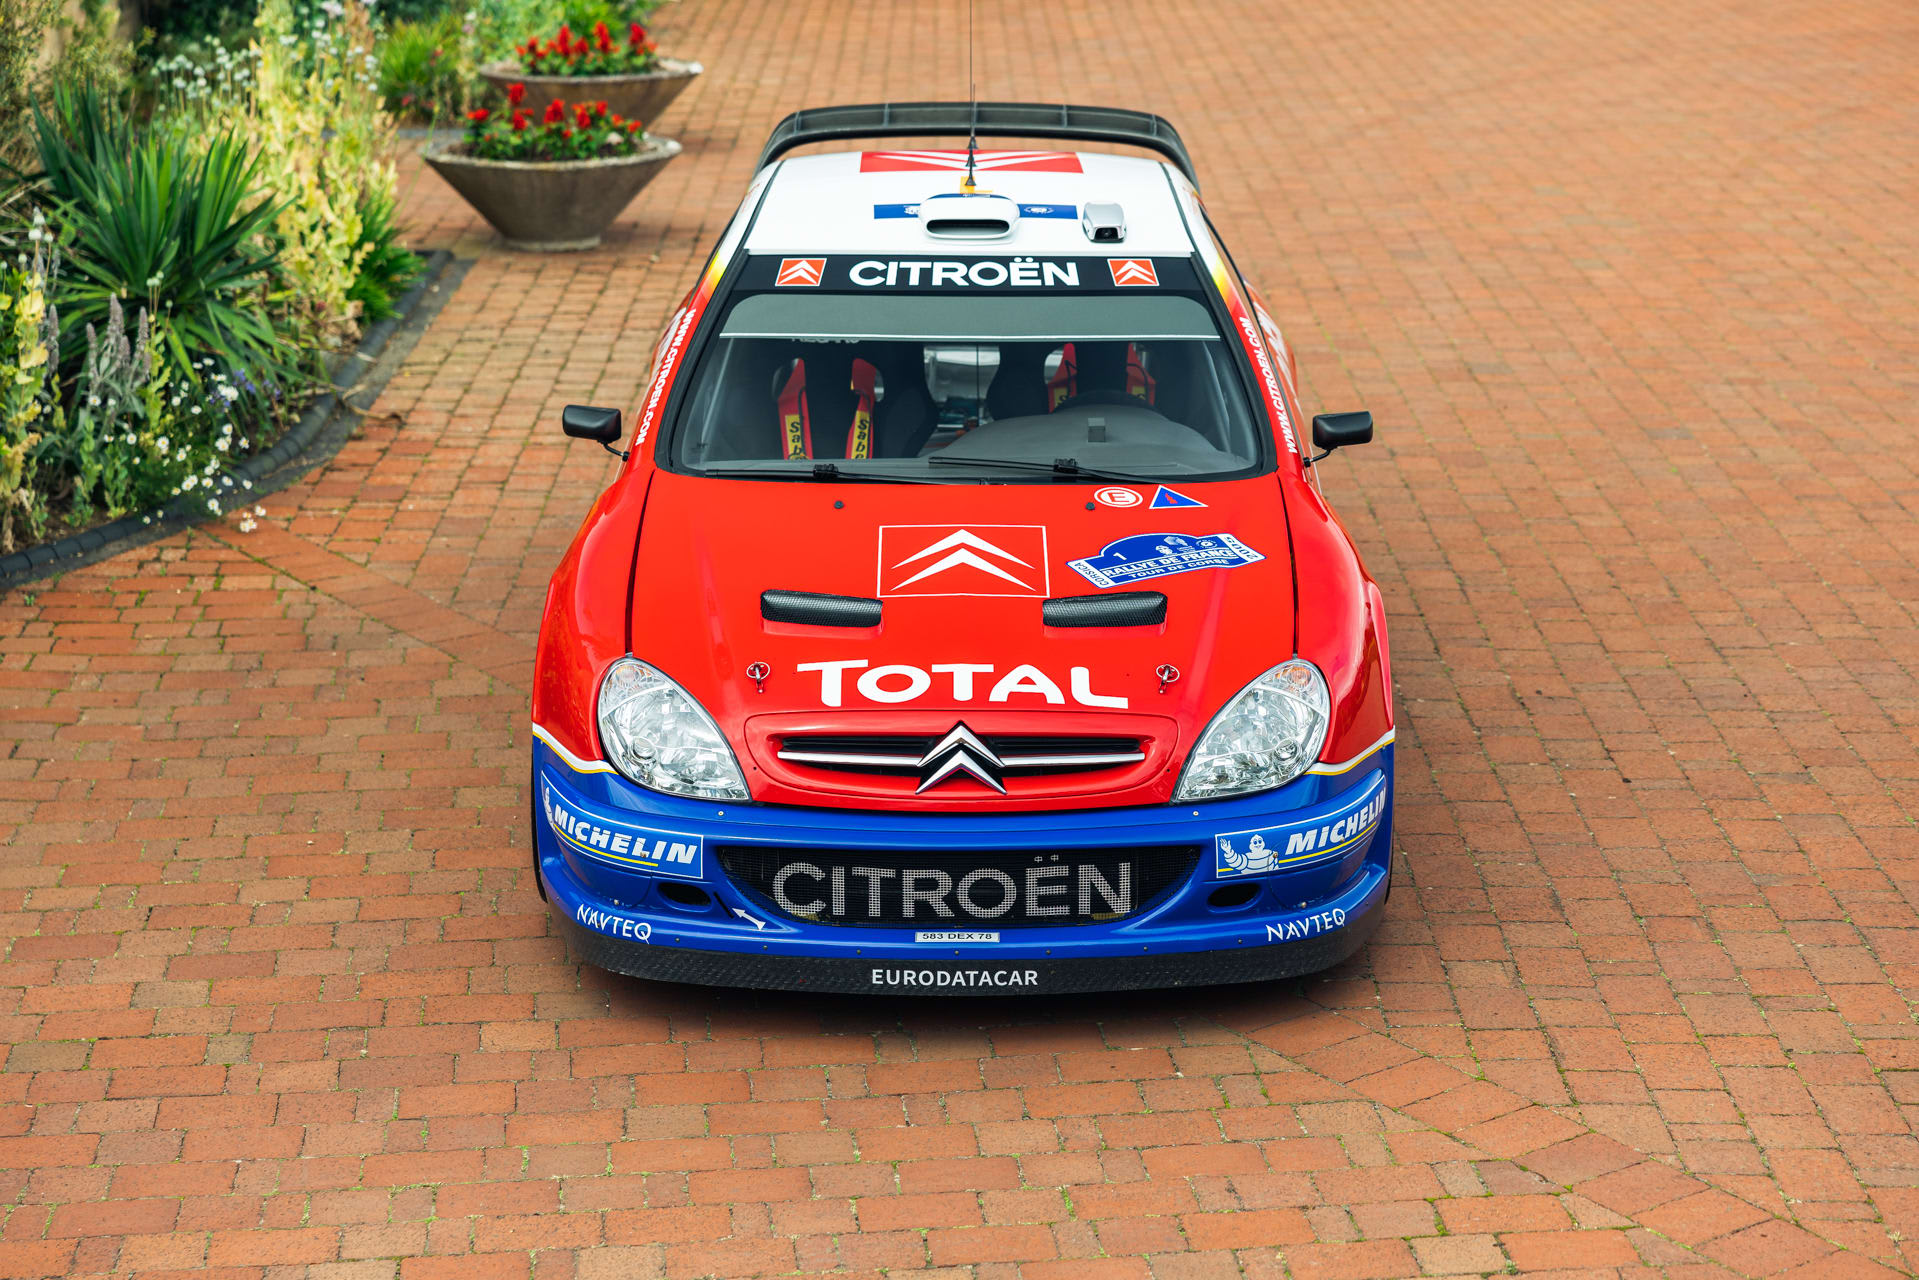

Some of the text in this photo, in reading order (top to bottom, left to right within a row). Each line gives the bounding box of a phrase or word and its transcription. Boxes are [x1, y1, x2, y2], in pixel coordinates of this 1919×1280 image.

[849, 256, 1080, 287] CITROËN
[1239, 316, 1298, 454] WWW.CITROEN.COM
[1074, 562, 1110, 586] CORSICA
[1103, 560, 1159, 577] RALLYE
[1159, 556, 1183, 567] DE
[1181, 548, 1237, 562] FRANCE
[1128, 558, 1231, 579] TOUR DE CORSE
[797, 659, 1129, 709] TOTAL
[554, 804, 698, 864] MICHELIN
[1285, 787, 1387, 856] MICHELIN
[772, 854, 1131, 919] CITROËN
[577, 903, 652, 945] NAVTEQ
[1266, 908, 1346, 942] NAVTEQ
[872, 968, 1038, 987] EURODATACAR
